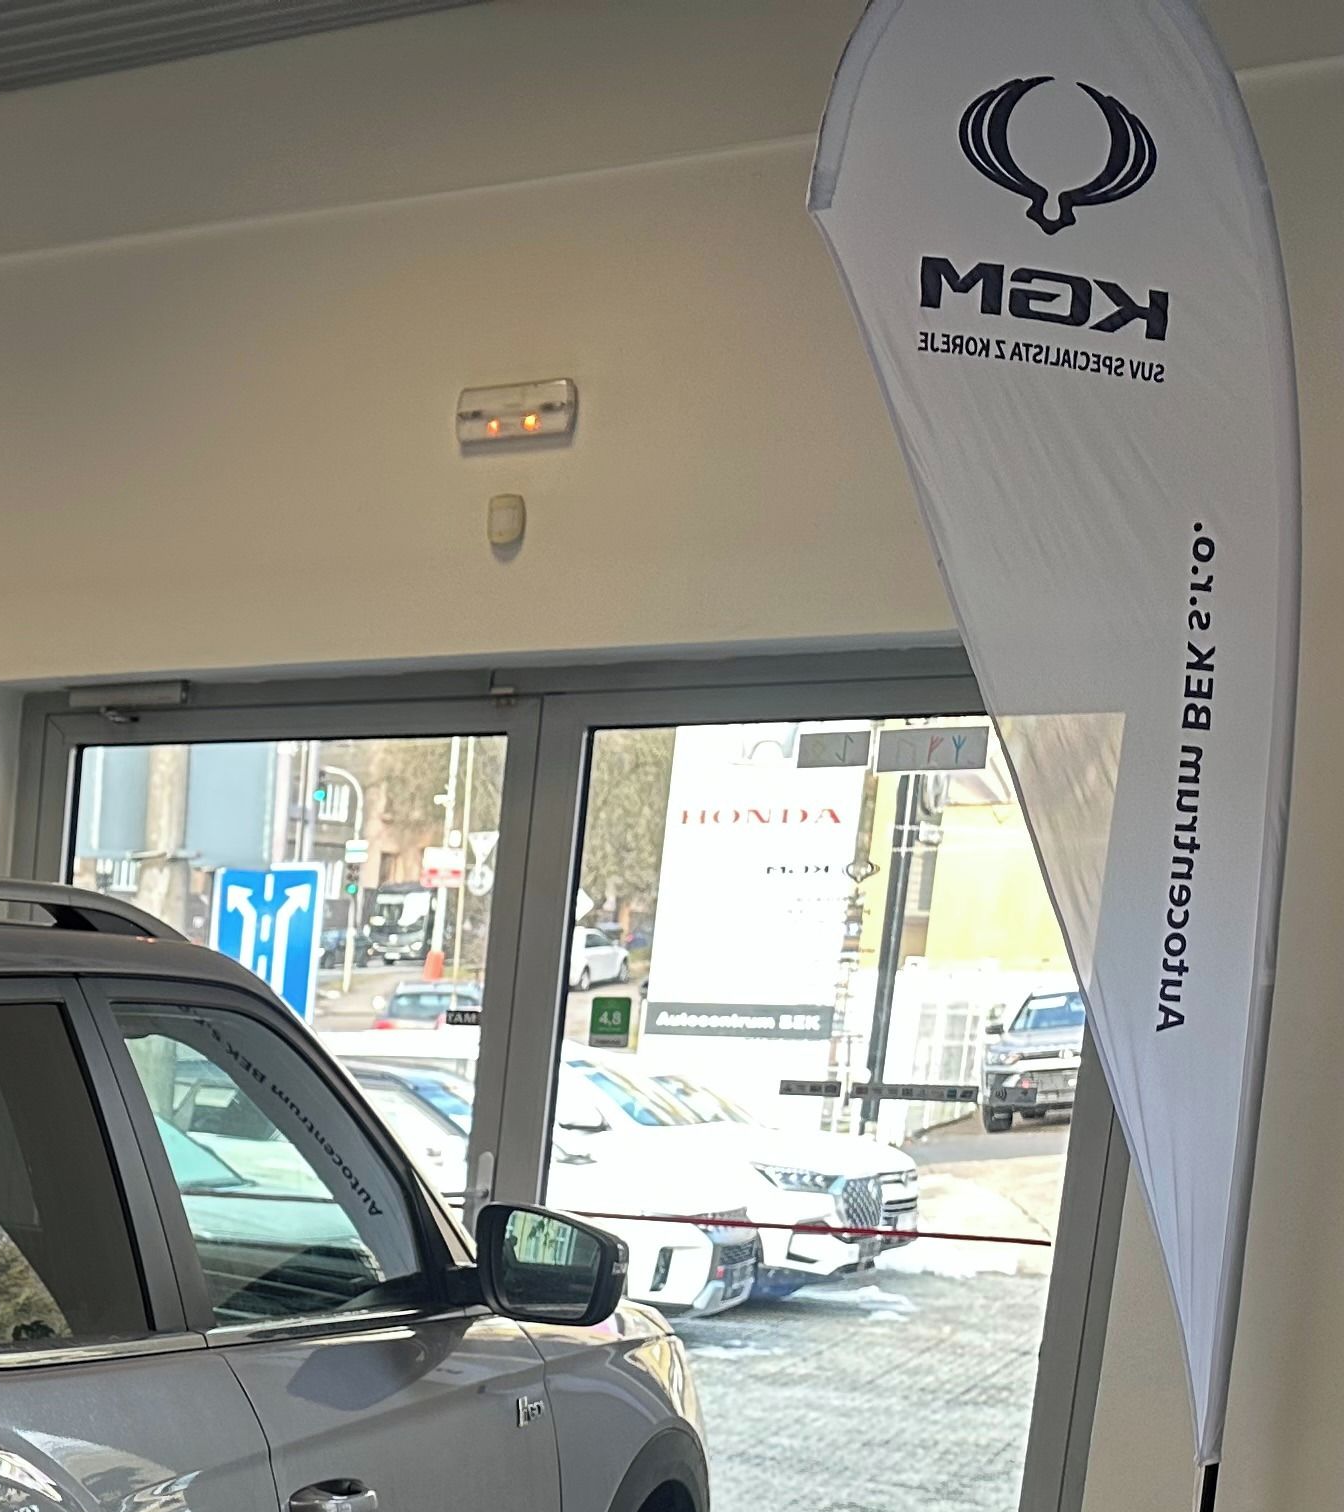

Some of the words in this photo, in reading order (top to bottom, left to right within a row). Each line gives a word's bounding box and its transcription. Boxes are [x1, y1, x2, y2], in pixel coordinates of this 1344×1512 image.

[681, 808, 841, 825] HONDA
[226, 1041, 267, 1086] BEK
[270, 1083, 384, 1217] Autocentrum
